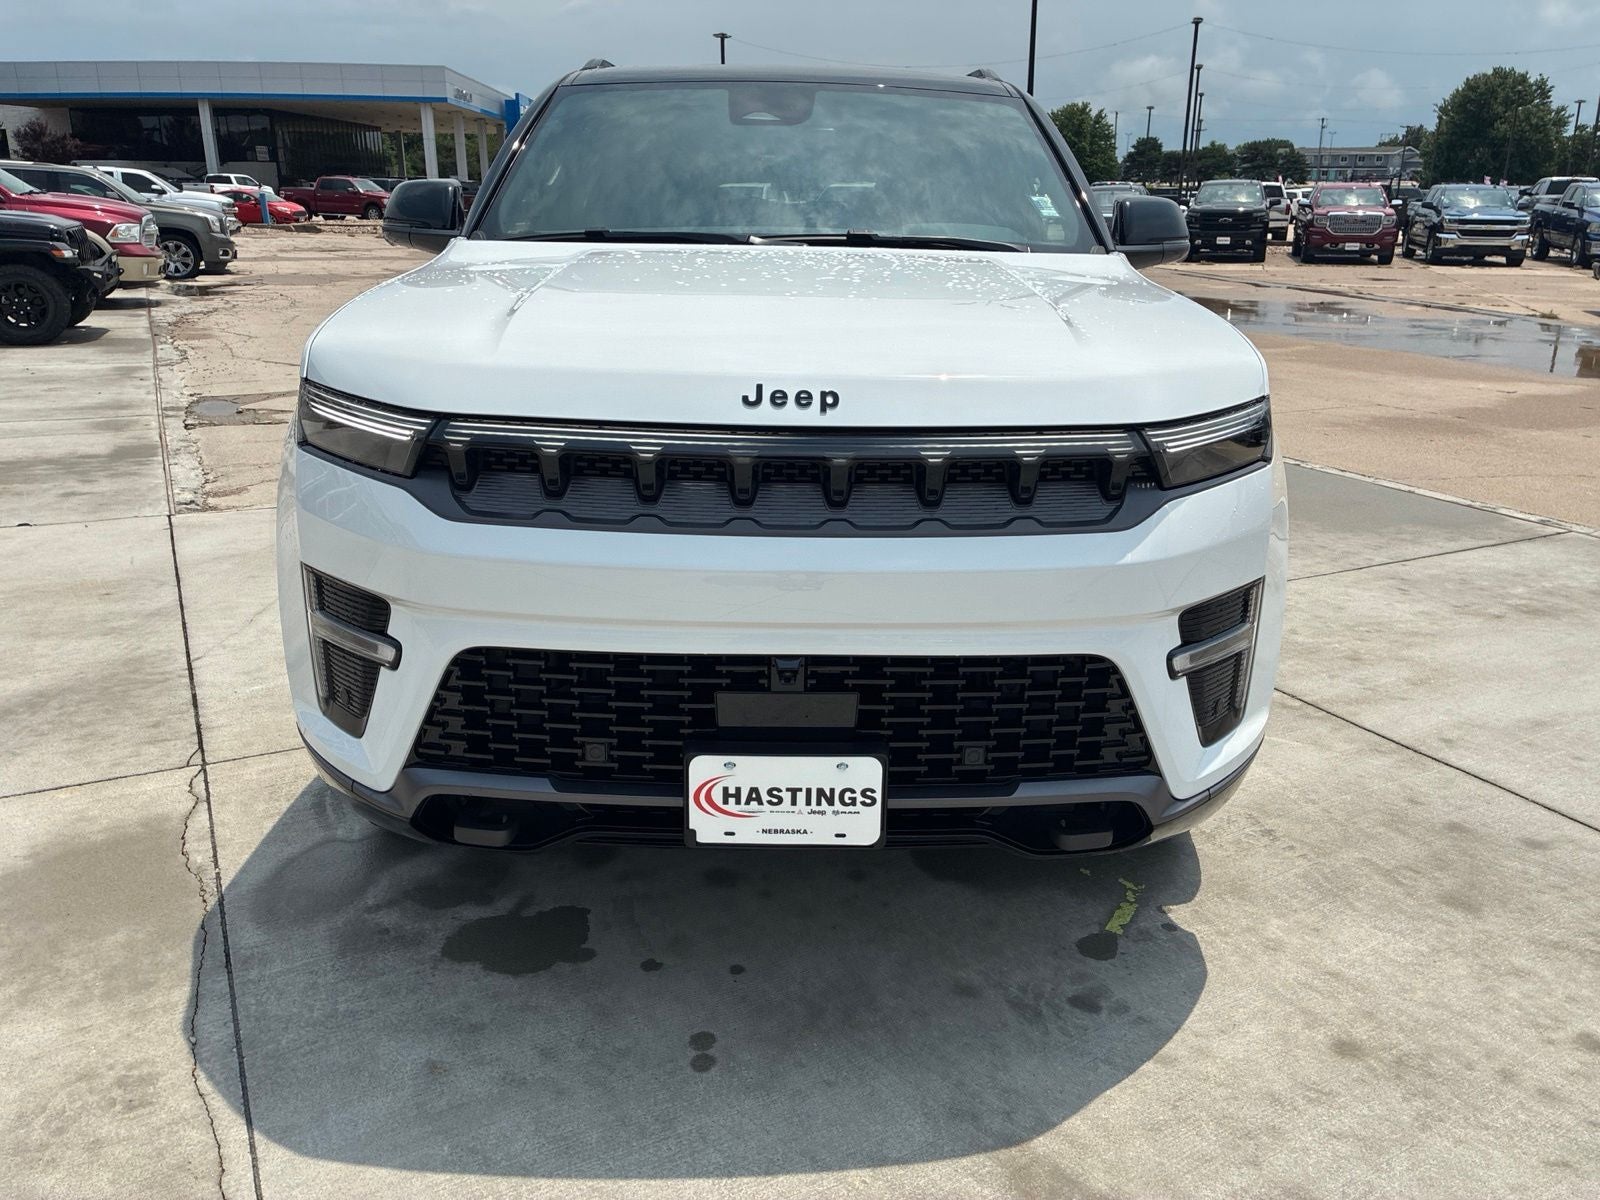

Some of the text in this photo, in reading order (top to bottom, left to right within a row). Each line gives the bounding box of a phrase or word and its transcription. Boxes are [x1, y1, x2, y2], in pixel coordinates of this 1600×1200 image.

[741, 383, 840, 415] Jeep
[722, 786, 877, 807] HASTINGS
[807, 808, 827, 816] Jeep
